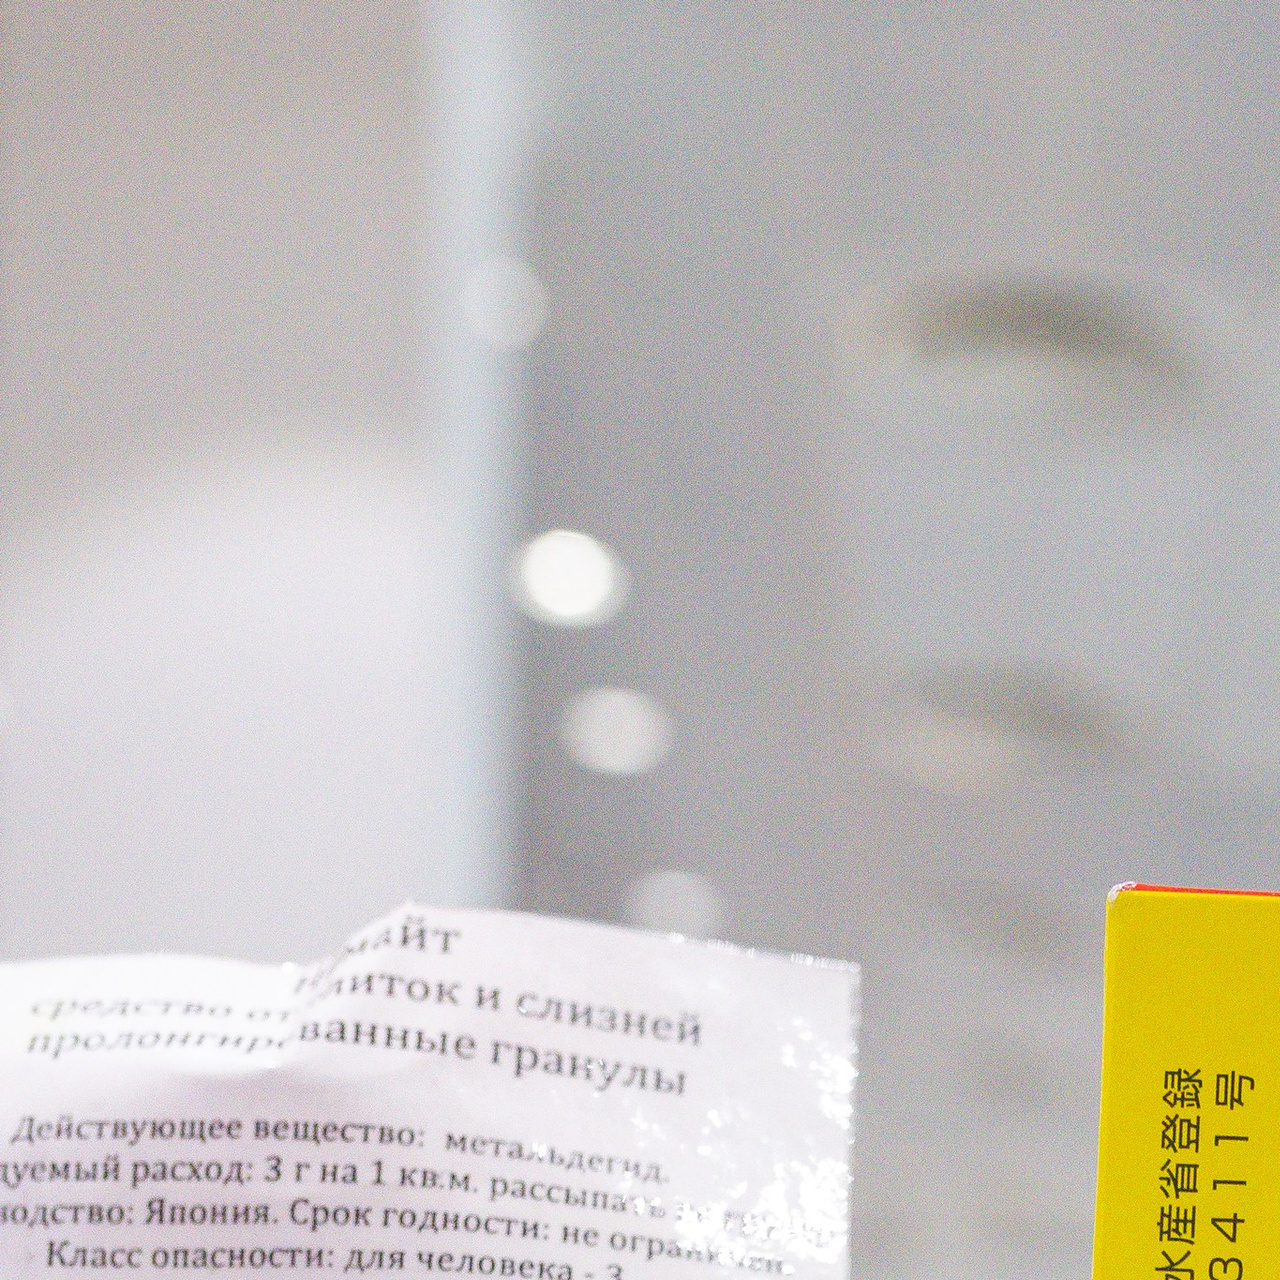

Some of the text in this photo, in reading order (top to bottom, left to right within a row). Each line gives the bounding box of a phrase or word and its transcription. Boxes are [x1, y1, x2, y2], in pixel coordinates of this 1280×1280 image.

[475, 982, 502, 1012] и
[517, 992, 701, 1046] слизней
[491, 1036, 686, 1097] гранулы
[10, 1115, 243, 1147] Действующее
[253, 1121, 426, 1147] вещество:
[131, 1163, 254, 1187] расход:
[264, 1155, 283, 1183] 3
[295, 1163, 310, 1183] г
[320, 1162, 358, 1185] на
[372, 1158, 386, 1186] 1
[400, 1166, 478, 1194] кв.м.
[146, 1198, 279, 1227] Япония.
[289, 1198, 371, 1233] Срок
[382, 1205, 550, 1243] годности:
[562, 1223, 599, 1247] не
[46, 1239, 143, 1270] Класс
[151, 1245, 335, 1271] опасности:
[343, 1250, 404, 1275] для
